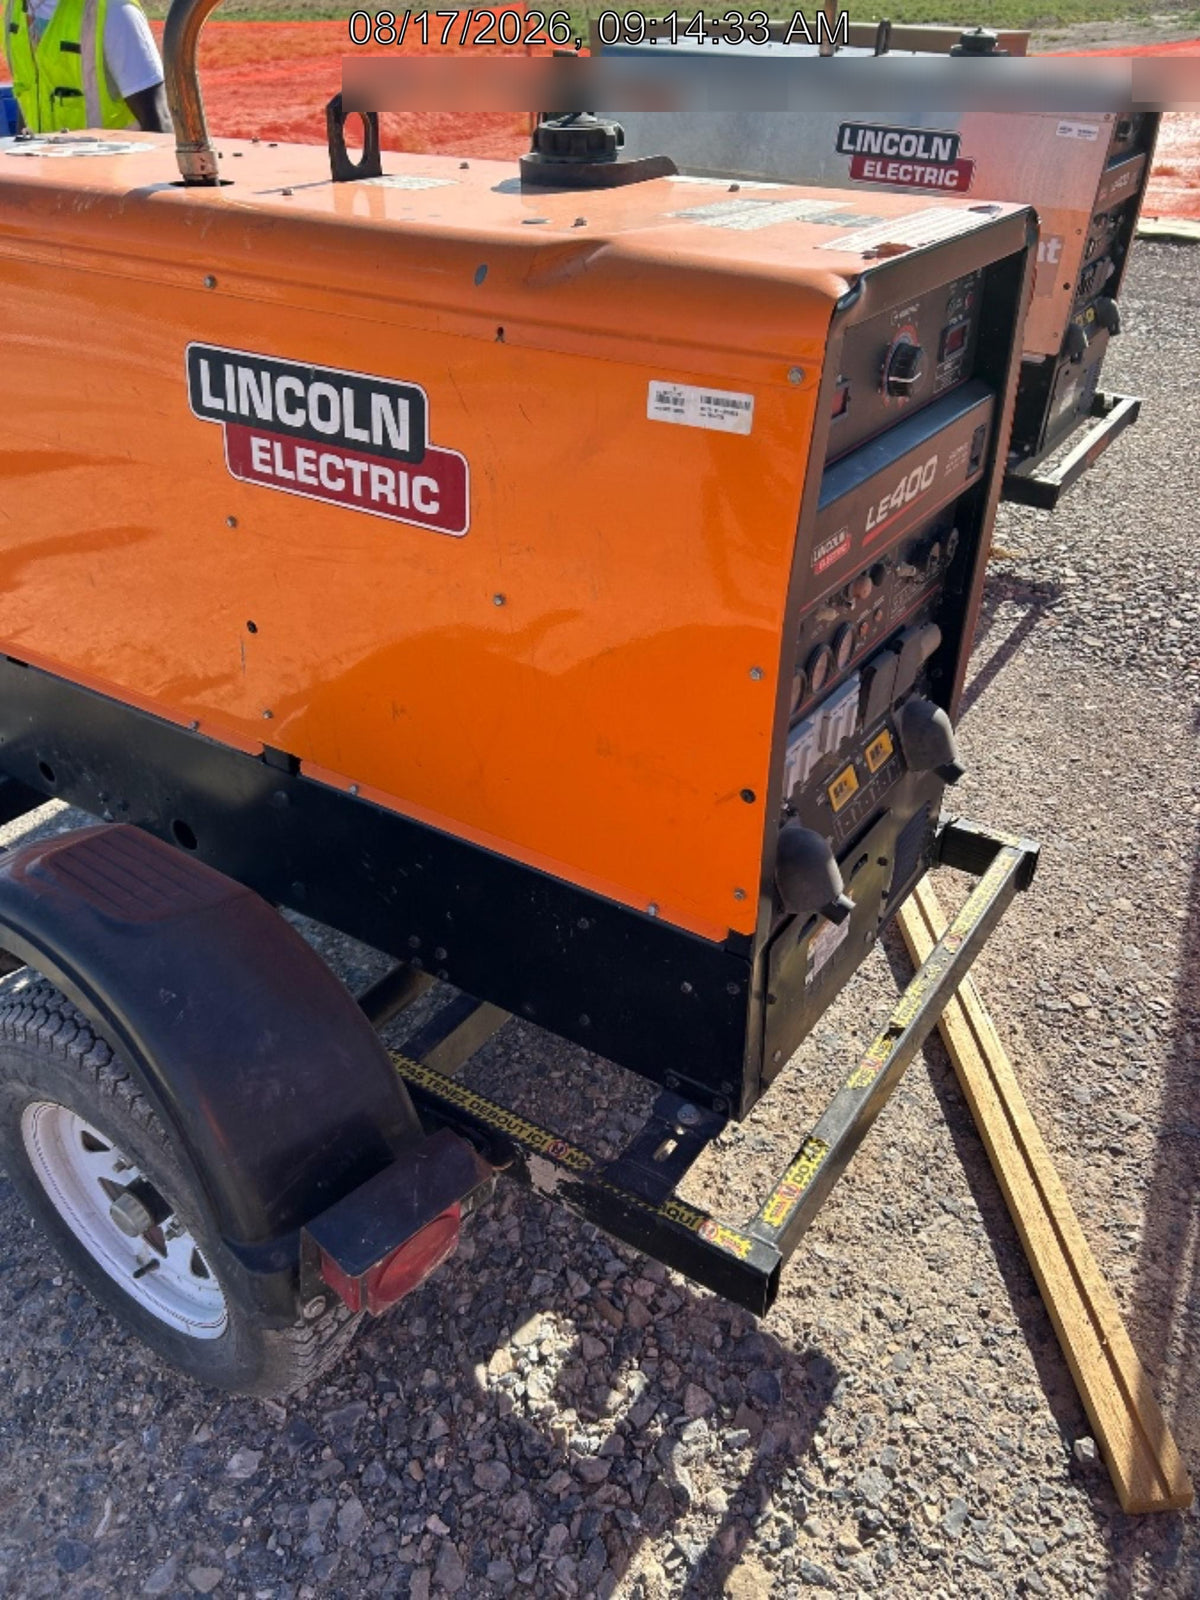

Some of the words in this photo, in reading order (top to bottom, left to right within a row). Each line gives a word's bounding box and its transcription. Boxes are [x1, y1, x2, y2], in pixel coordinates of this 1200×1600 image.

[842, 127, 953, 161] LINCOLN
[862, 160, 960, 187] ELECTRIC
[199, 358, 411, 452] LINCOLN
[250, 436, 440, 515] ELECTRIC
[865, 454, 938, 532] LE400
[427, 1076, 468, 1103] TENEZ
[468, 1100, 528, 1133] DEBOUT
[526, 1131, 549, 1146] ICI
